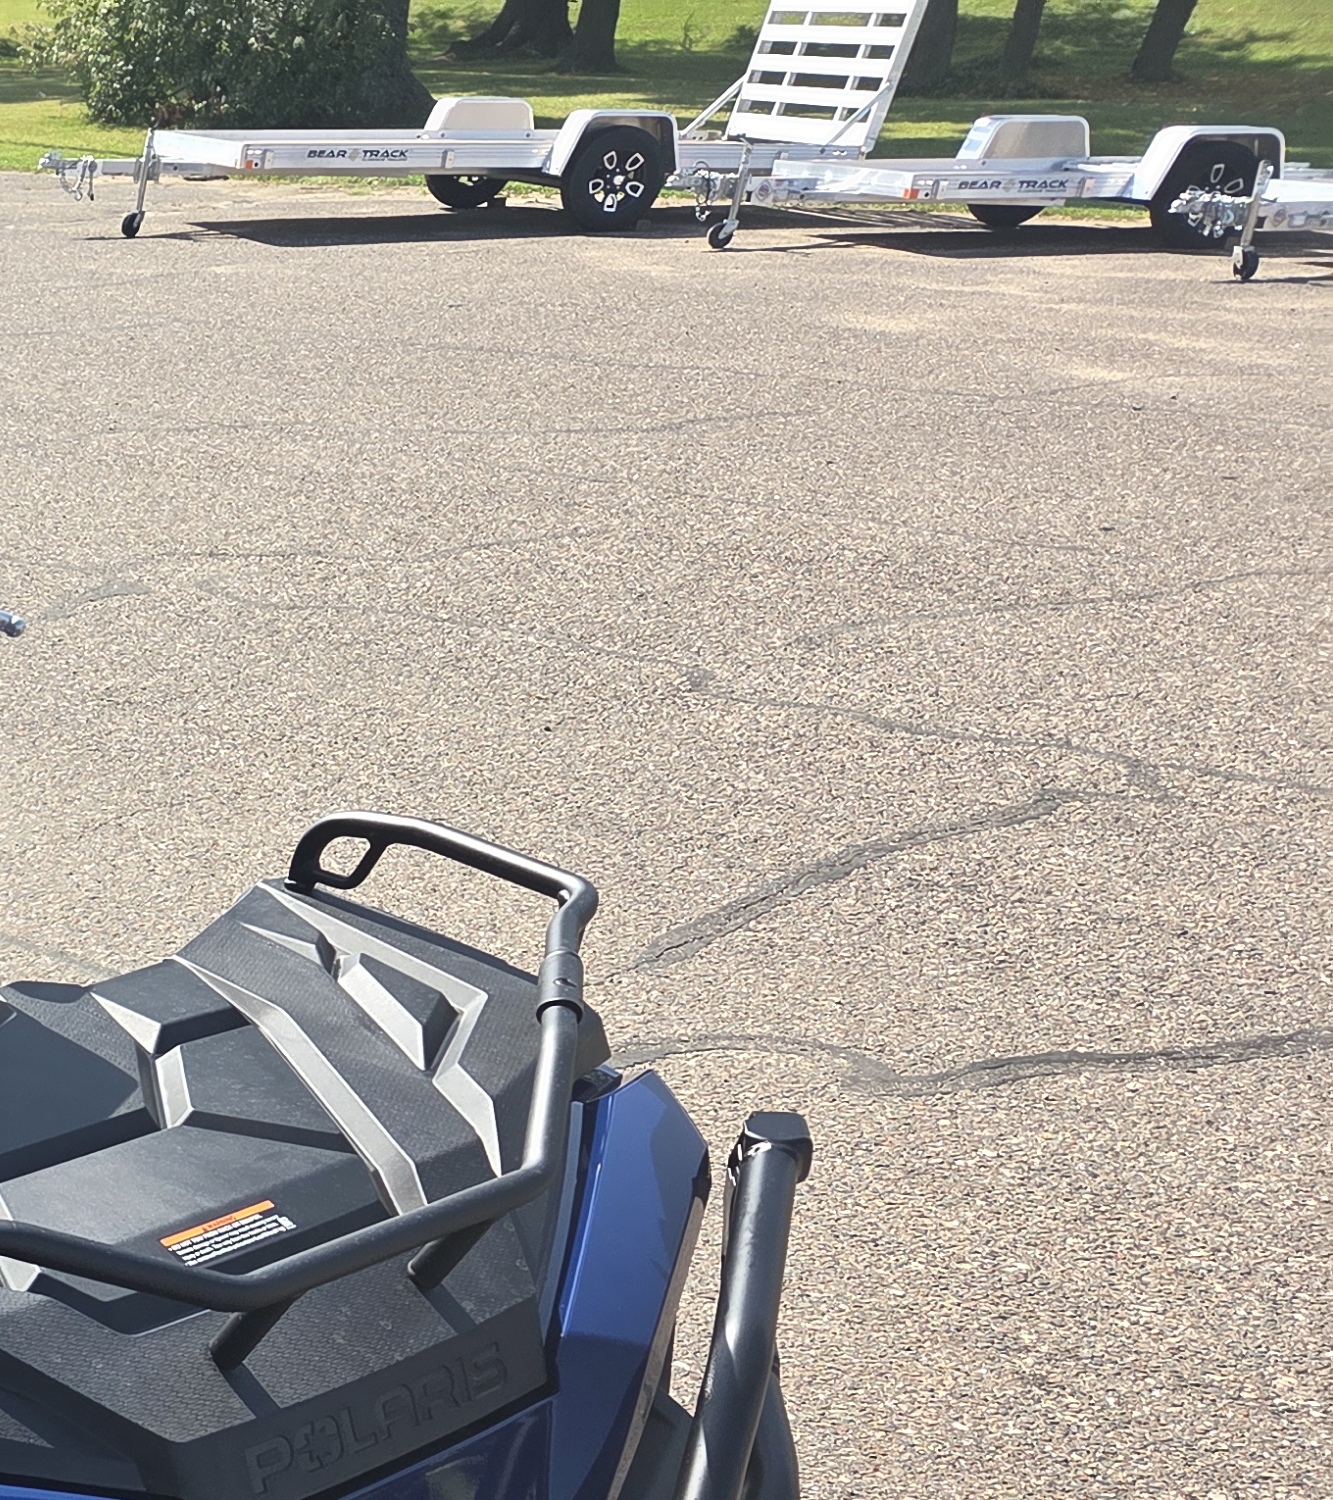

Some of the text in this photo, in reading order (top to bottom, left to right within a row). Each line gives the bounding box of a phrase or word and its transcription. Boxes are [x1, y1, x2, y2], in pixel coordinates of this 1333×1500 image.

[307, 149, 409, 158] BEAR TRACK
[958, 179, 1069, 189] BEAR TRACK
[245, 1341, 508, 1495] POLARIS
